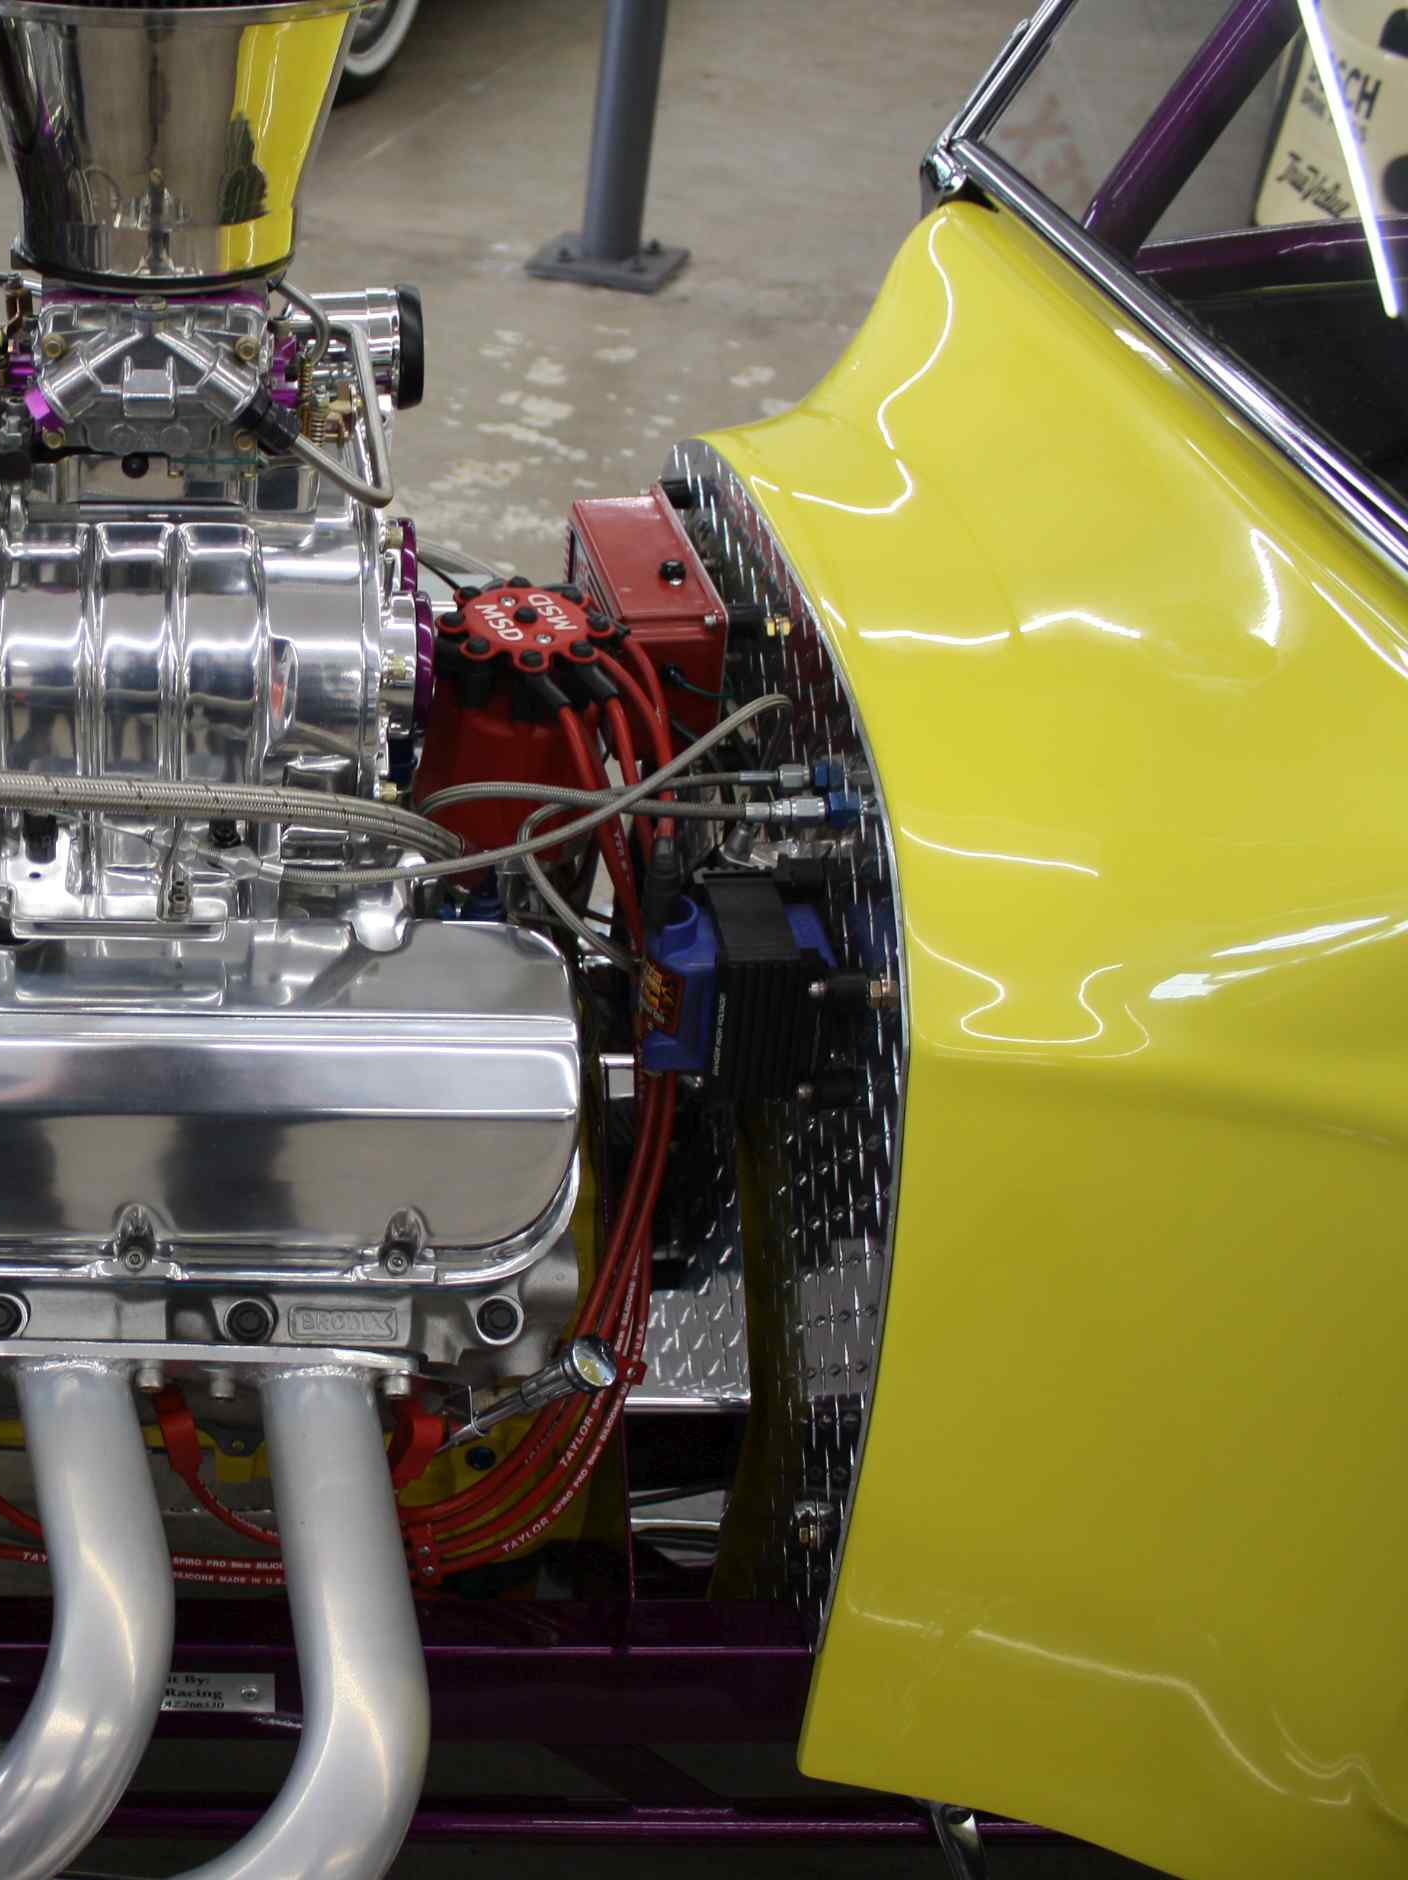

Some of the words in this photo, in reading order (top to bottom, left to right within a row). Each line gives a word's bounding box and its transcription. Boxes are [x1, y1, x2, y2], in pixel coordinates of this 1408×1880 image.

[475, 604, 524, 641] MSD
[528, 594, 578, 630] MSD
[559, 1414, 594, 1468] TAYLOR
[502, 1517, 550, 1553] TAYLOR
[165, 1687, 223, 1700] Racing
